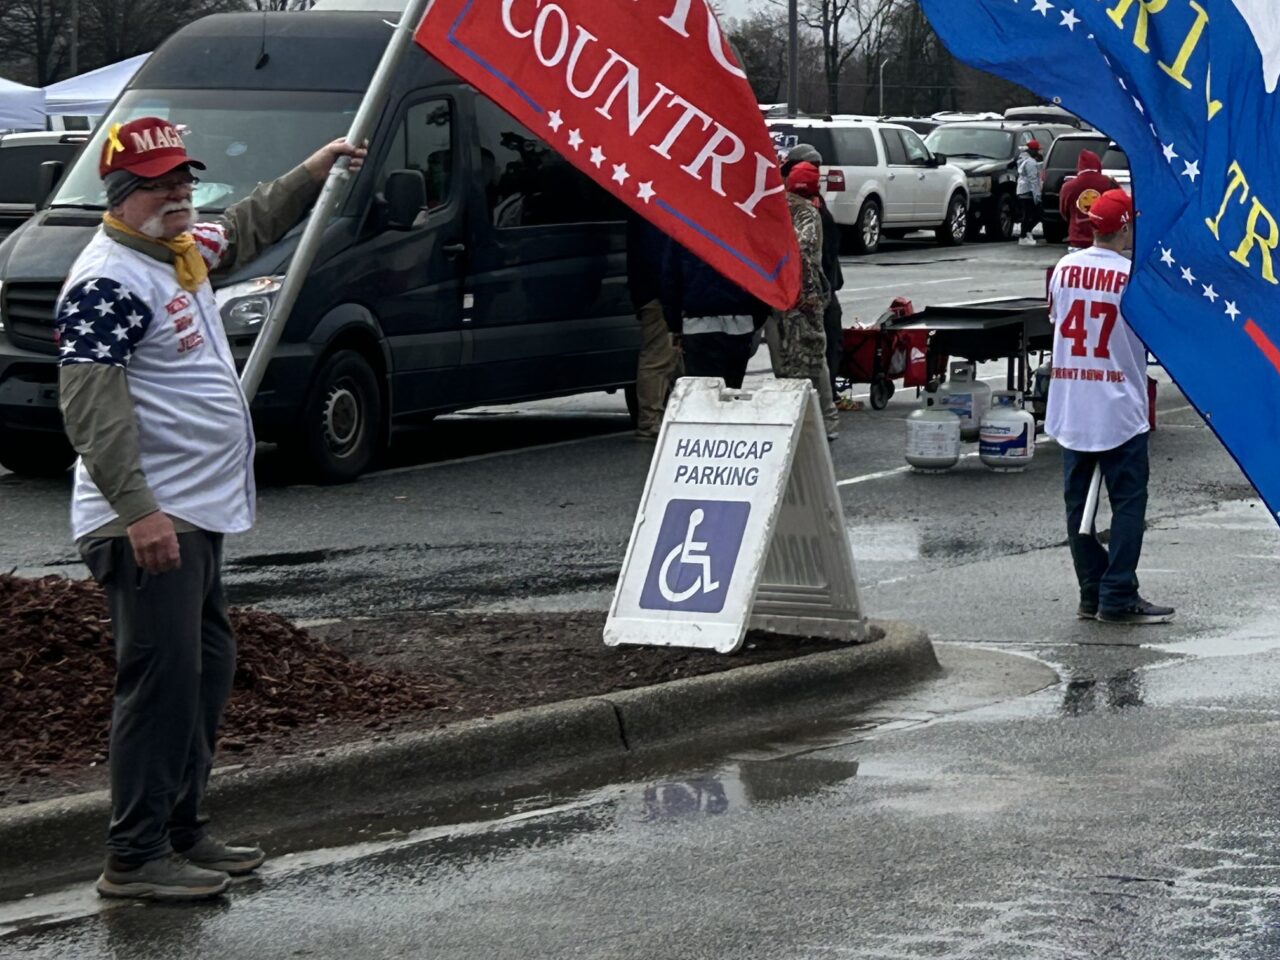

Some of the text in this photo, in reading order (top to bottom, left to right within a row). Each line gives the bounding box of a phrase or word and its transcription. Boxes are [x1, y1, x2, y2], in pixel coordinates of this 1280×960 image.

[1060, 265, 1128, 294] TRUMP
[1060, 299, 1118, 359] 47
[675, 439, 774, 460] HANDICAP
[674, 465, 760, 487] PARKING
